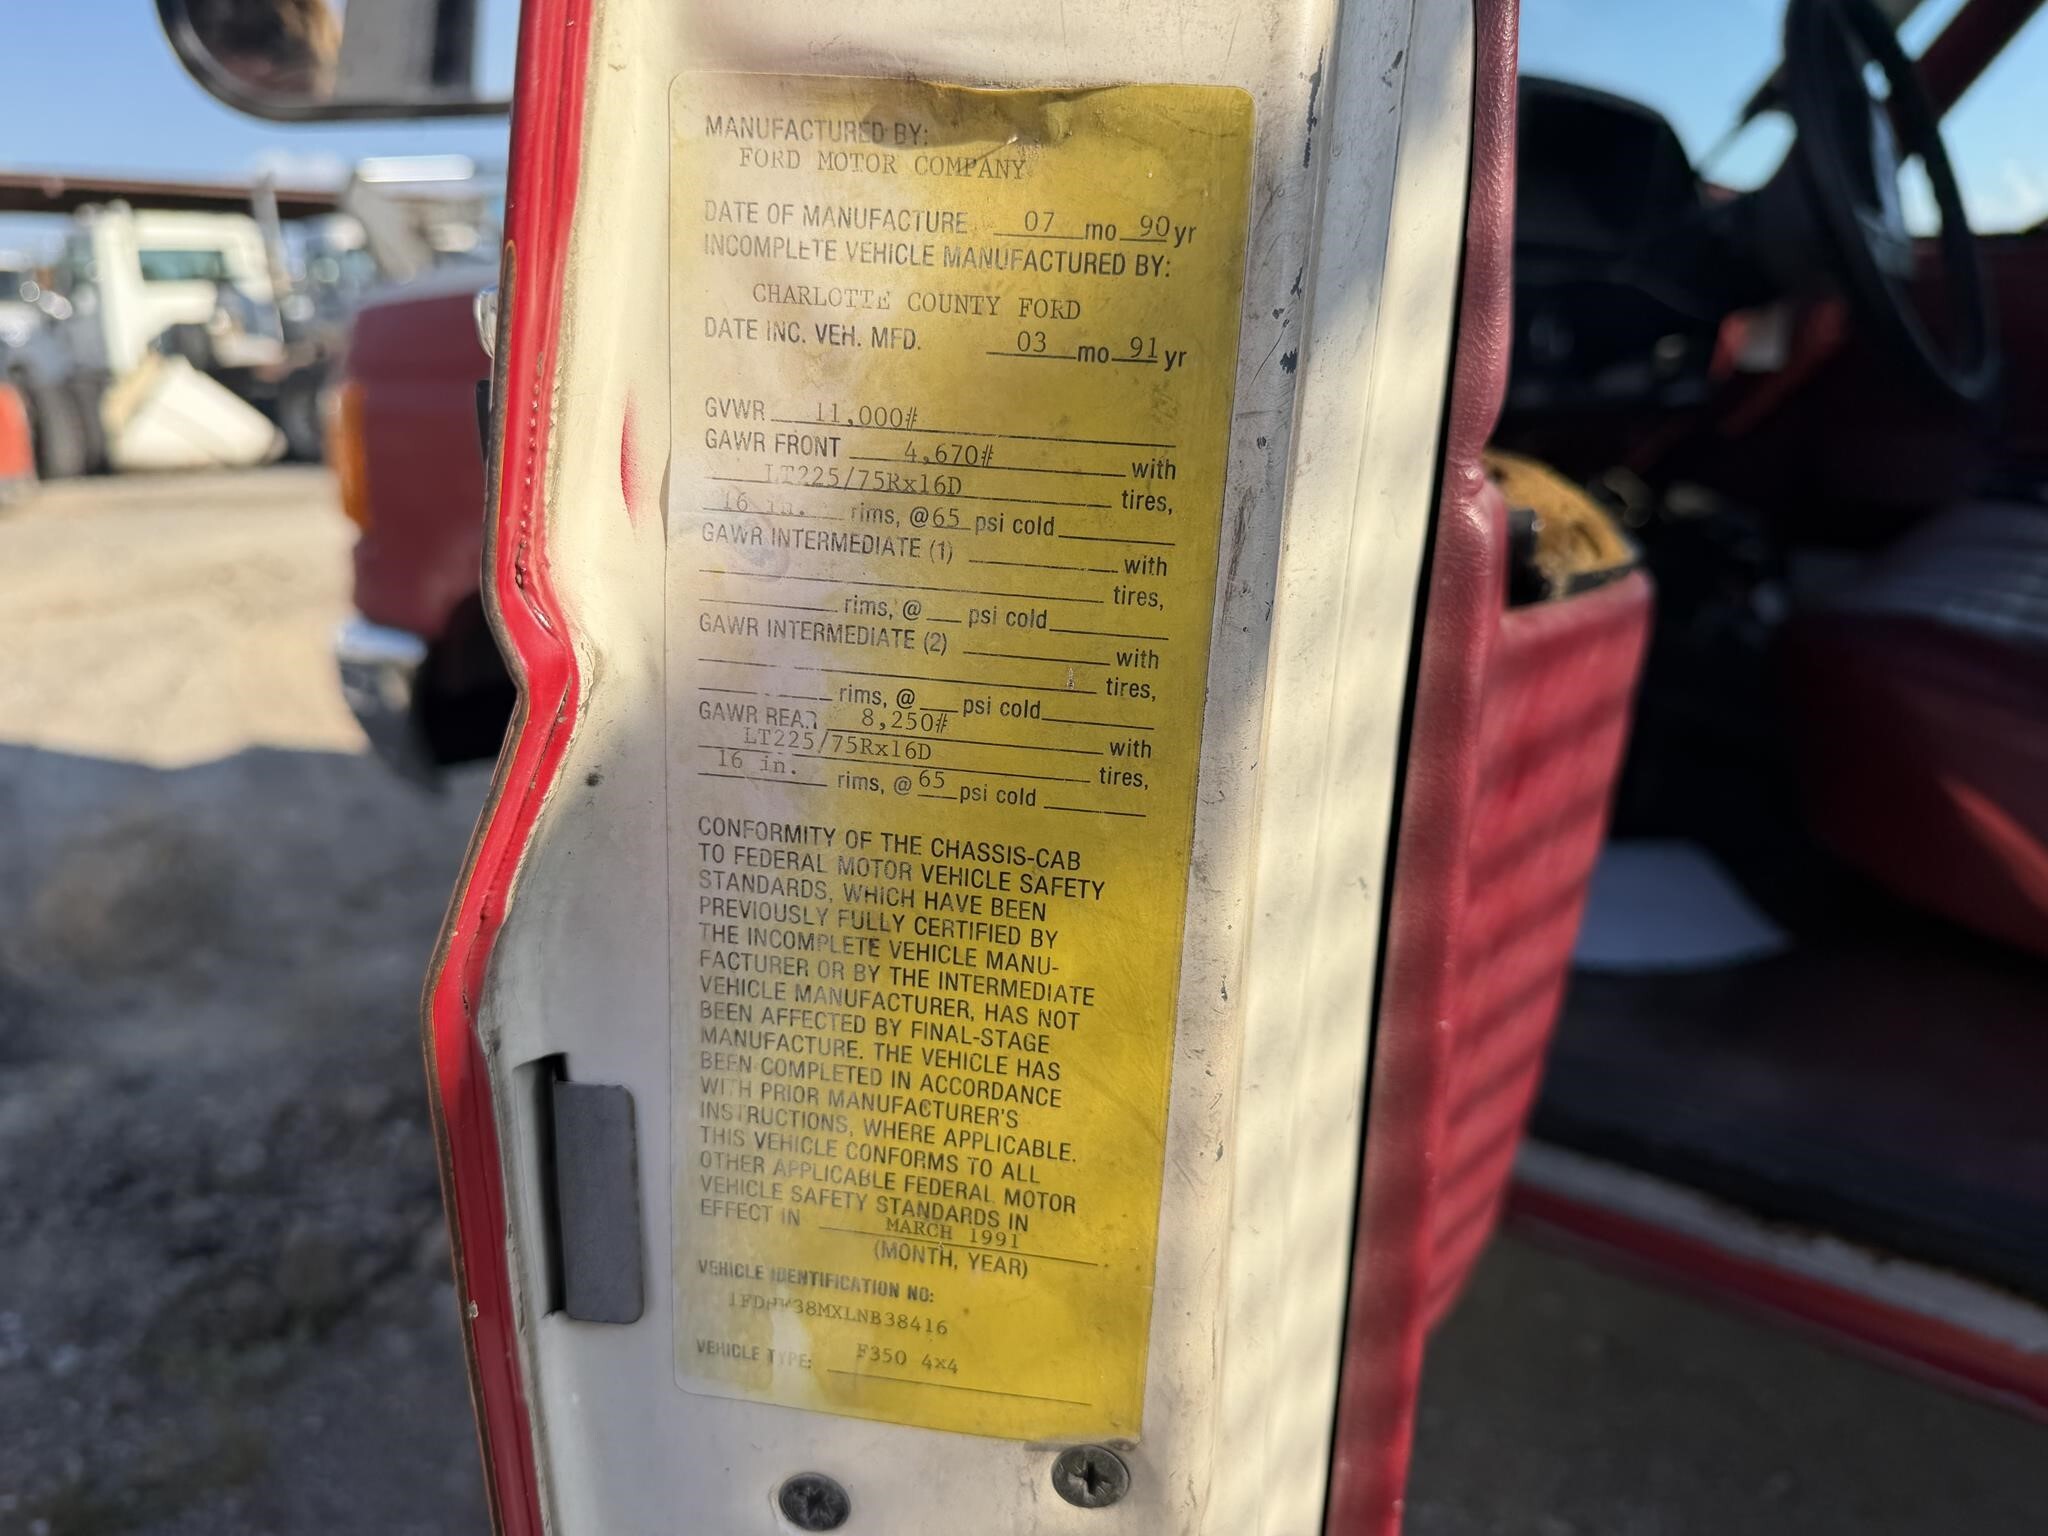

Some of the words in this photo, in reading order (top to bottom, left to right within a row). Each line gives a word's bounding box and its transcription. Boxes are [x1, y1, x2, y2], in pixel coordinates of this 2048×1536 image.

[705, 115, 884, 143] MANUFACTURED
[894, 121, 928, 146] BY:
[740, 148, 800, 169] FORD
[818, 151, 898, 174] MOTOR
[914, 155, 1025, 179] COMPANY
[705, 200, 758, 223] DATE
[768, 202, 794, 225] OF
[803, 205, 968, 234] MANUFACTURE
[1025, 211, 1055, 232] 07
[1085, 223, 1116, 241] mo
[1140, 215, 1170, 237] 90
[1175, 225, 1197, 248] yr
[705, 233, 837, 261] INCOMPLETE
[846, 240, 934, 266] VEHICLE
[944, 246, 1125, 275] MANUFACTURED
[1136, 254, 1170, 278] BY:
[753, 283, 890, 310] CHARLOTTE
[907, 292, 1000, 316] COUNTY
[1019, 297, 1080, 320] FORD
[705, 317, 757, 339] DATE
[767, 321, 806, 344] INC.
[815, 323, 861, 347] VEH.
[871, 327, 921, 350] MFD.
[1018, 331, 1046, 352] 03
[1077, 345, 1109, 363] mo
[1130, 336, 1158, 358] 91
[1165, 350, 1187, 371] yr
[705, 397, 765, 421] GVWR
[816, 402, 917, 431] 11,000#
[706, 428, 765, 452] GAWR
[775, 434, 841, 458] FRONT
[904, 441, 993, 467] 4,670#
[1132, 461, 1176, 480] with
[723, 491, 748, 511] 16
[850, 502, 900, 527] rims,
[976, 514, 1004, 535] psi
[1013, 516, 1054, 536] cold
[1122, 489, 1173, 515] tires,
[703, 522, 762, 545] GAWR
[772, 528, 921, 558] INTERMEDIATE
[930, 540, 952, 564] (1)
[1124, 556, 1167, 576] with
[845, 594, 893, 619] rims,
[969, 605, 997, 628] psi
[1006, 609, 1047, 629] cold
[1114, 585, 1164, 611] tires,
[700, 612, 758, 636] GAWR
[768, 619, 915, 649] INTERMEDIATE
[924, 632, 948, 656] (2)
[1117, 649, 1159, 669] with
[839, 684, 887, 708] rims,
[963, 696, 991, 717] psi
[1000, 700, 1040, 719] cold
[1106, 677, 1156, 701] tires,
[700, 701, 757, 724] GAWR
[862, 708, 948, 733] 8,250#
[1110, 739, 1151, 759] with
[718, 749, 743, 769] 16
[760, 755, 797, 774] in.
[838, 771, 884, 795] rims,
[960, 784, 987, 804] psi
[996, 787, 1036, 807] cold
[744, 727, 931, 760] LT225/75Rx16D
[1100, 767, 1148, 790] tires,
[699, 816, 836, 847] CONFORMITY
[846, 829, 872, 849] OF
[881, 832, 921, 856] THE
[931, 838, 1080, 871] CHASSIS-CAB
[699, 843, 724, 863] TO
[734, 846, 828, 873] FEDERAL
[838, 855, 912, 882] MOTOR
[921, 863, 1011, 891] VEHICLE
[1020, 874, 1105, 900] SAFETY
[699, 869, 832, 903] STANDARDS,
[844, 883, 914, 908] WHICH
[925, 891, 982, 915] HAVE
[992, 898, 1046, 921] BEEN
[699, 922, 738, 944] THE
[748, 928, 880, 957] INCOMPLETE
[889, 940, 976, 967] VEHICLE
[986, 950, 1058, 975] MANU-
[700, 896, 828, 926] PREVIOUSLY
[839, 910, 905, 933] FULLY
[915, 916, 1020, 945] CERTIFIED
[1031, 929, 1058, 949] BY
[700, 950, 808, 977] FACTURER
[818, 960, 843, 980] OR
[854, 964, 880, 983] BY
[890, 967, 929, 988] THE
[939, 971, 1095, 1006] INTERMEDIATE
[700, 975, 785, 1001] VEHICLE
[795, 984, 974, 1021] MANUFACTURER,
[985, 1003, 1028, 1025] HAS
[1038, 1009, 1080, 1030] NOT
[700, 1000, 751, 1023] BEEN
[762, 1007, 865, 1033] AFFECTED
[876, 1018, 901, 1037] BY
[912, 1021, 1049, 1054] FINAL-STAGE
[700, 1026, 863, 1060] MANUFACTURE.
[874, 1043, 912, 1064] THE
[922, 1048, 1008, 1075] VEHICLE
[1017, 1059, 1060, 1081] HAS
[700, 1051, 751, 1073] BEEN
[761, 1057, 882, 1086] COMPLETED
[890, 1070, 910, 1089] IN
[920, 1073, 1062, 1108] ACCORDANCE
[700, 1076, 751, 1098] WITH
[761, 1082, 818, 1105] PRIOR
[828, 1090, 1018, 1128] MANUFACTURER'S
[699, 1126, 745, 1147] THIS
[754, 1132, 837, 1157] VEHICLE
[847, 1142, 958, 1173] CONFORMS
[968, 1157, 992, 1177] TO
[1001, 1162, 1040, 1184] ALL
[701, 1102, 852, 1137] INSTRUCTIONS,
[864, 1119, 935, 1144] WHERE
[944, 1128, 1076, 1162] APPLICABLE.
[700, 1151, 764, 1174] OTHER
[773, 1158, 896, 1191] APPLICABLE
[905, 1175, 991, 1203] FEDERAL
[1005, 1188, 1076, 1214] MOTOR
[700, 1175, 783, 1200] VEHICLE
[791, 1185, 867, 1212] SAFETY
[877, 1196, 999, 1228] STANDARDS
[1009, 1213, 1028, 1232] IN
[701, 1199, 773, 1222] EFFECT
[782, 1208, 799, 1226] IN
[886, 1217, 952, 1240] MARCH
[970, 1228, 1019, 1249] 1991
[698, 1259, 764, 1280] VEHICLE
[770, 1267, 899, 1298] IDENTIFICATION
[907, 1285, 934, 1303] NO:
[875, 1239, 958, 1270] (MONTH,
[969, 1252, 1028, 1279] YEAR)
[697, 1339, 760, 1361] VEHICLE
[768, 1349, 812, 1369] TYPE:
[857, 1343, 907, 1366] F350
[922, 1354, 958, 1374] 4x4
